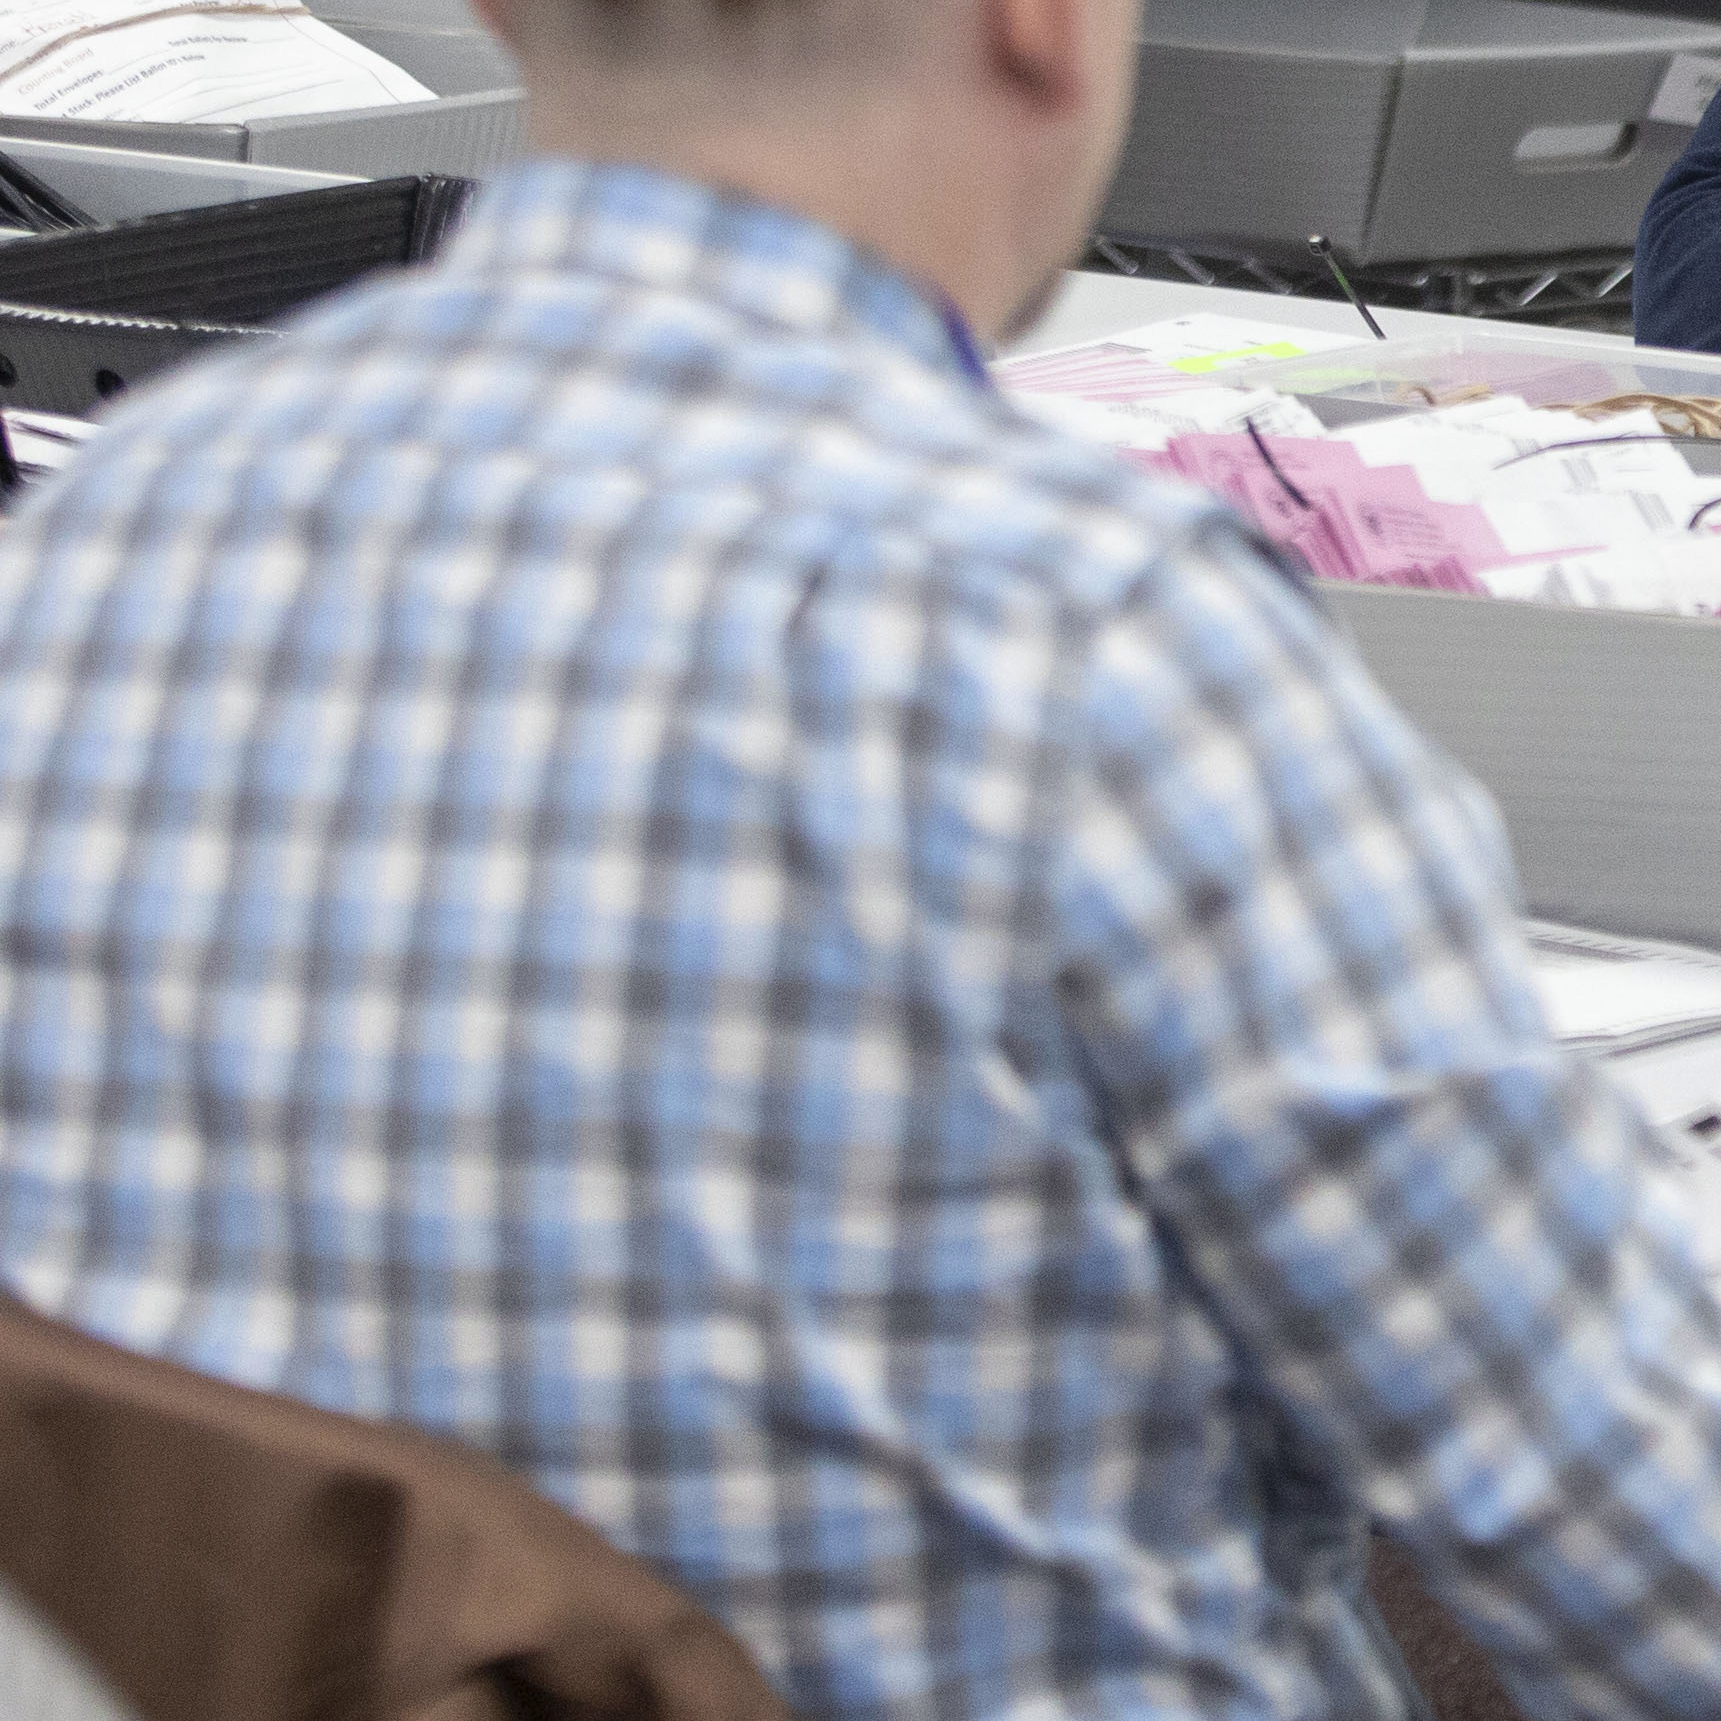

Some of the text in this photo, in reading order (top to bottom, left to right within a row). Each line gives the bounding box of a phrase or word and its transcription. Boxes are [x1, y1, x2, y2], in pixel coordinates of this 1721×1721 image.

[18, 47, 95, 96] Counting Board
[140, 61, 167, 79] Ballot
[33, 91, 59, 112] Total
